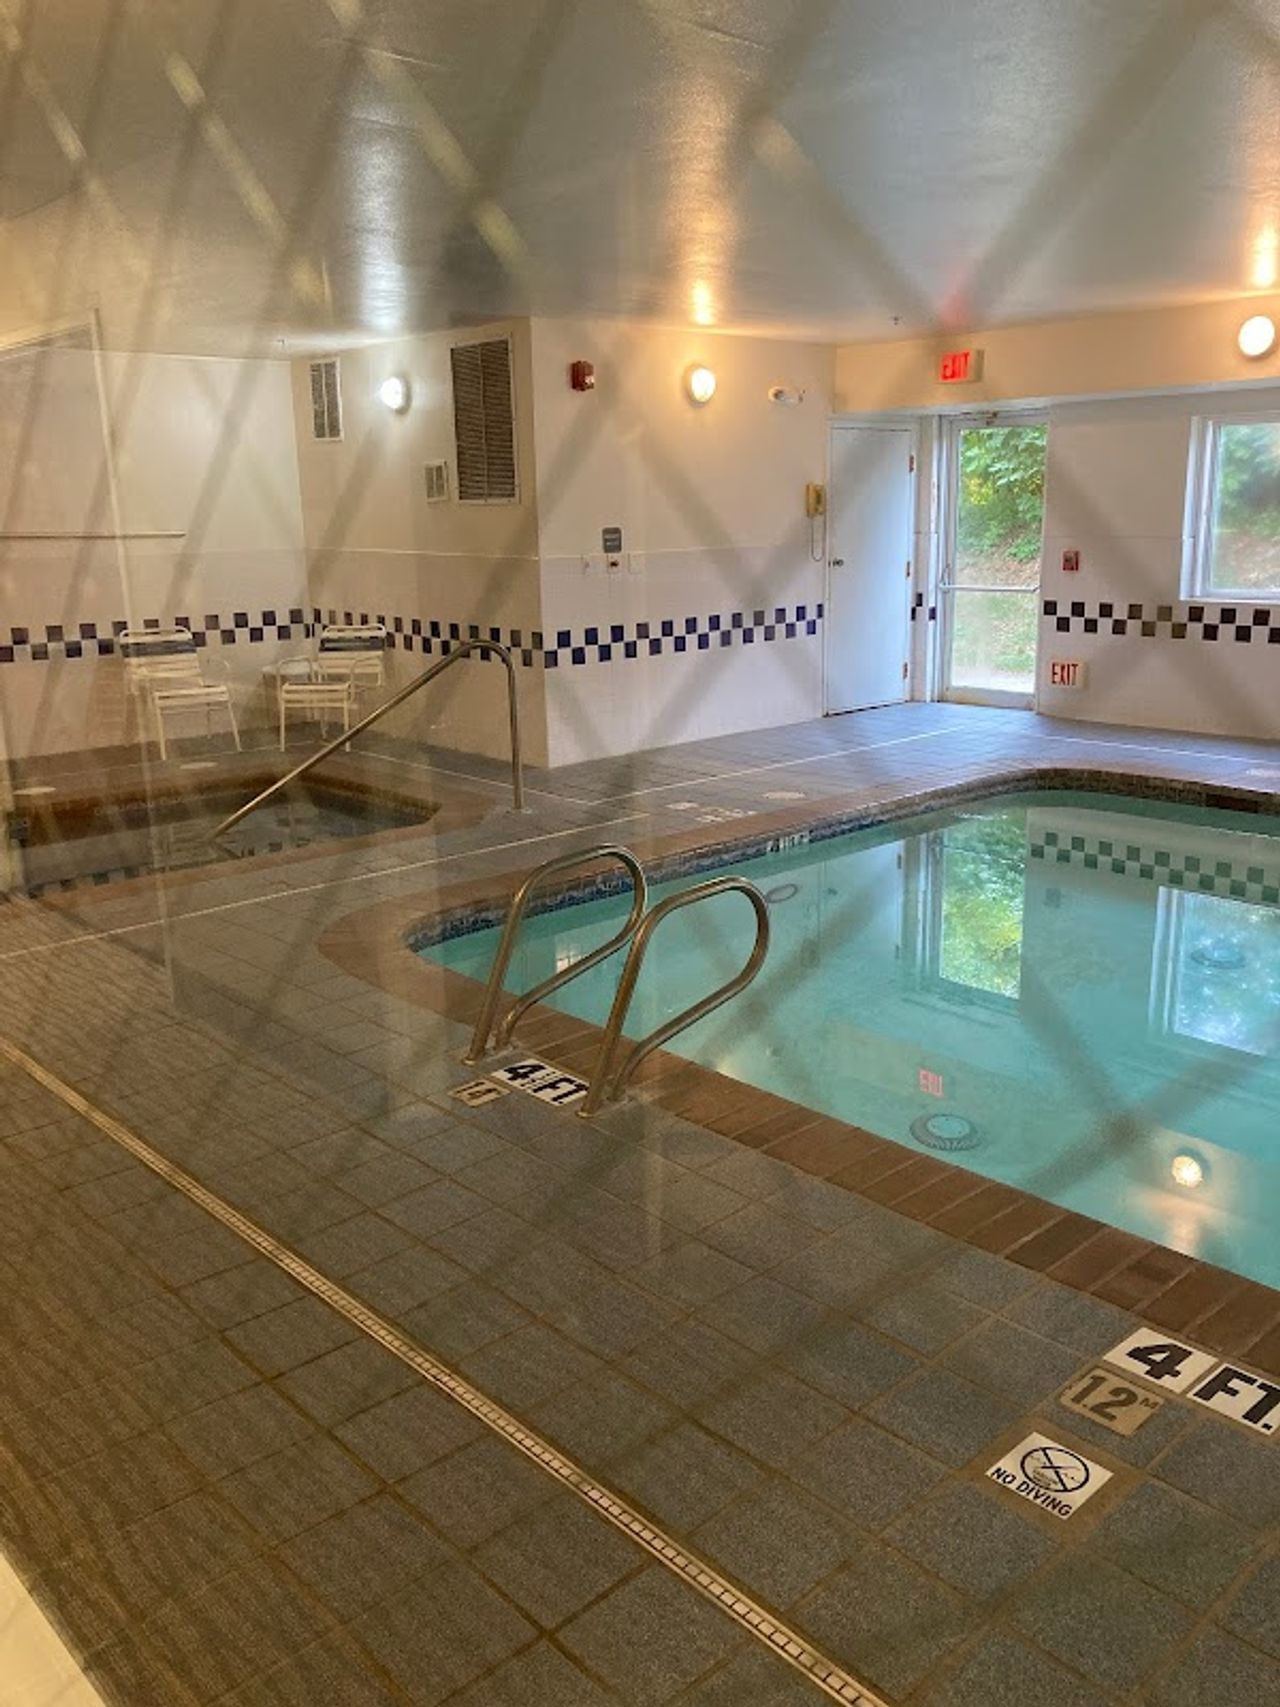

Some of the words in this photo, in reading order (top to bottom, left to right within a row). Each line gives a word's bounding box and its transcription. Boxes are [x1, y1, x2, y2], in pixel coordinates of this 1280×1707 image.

[941, 351, 970, 380] EXIT
[1051, 662, 1079, 686] EXIT
[503, 1064, 546, 1081] 4
[1125, 1342, 1194, 1381] 4
[990, 1466, 1016, 1486] NO
[1015, 1480, 1073, 1518] DIVING
